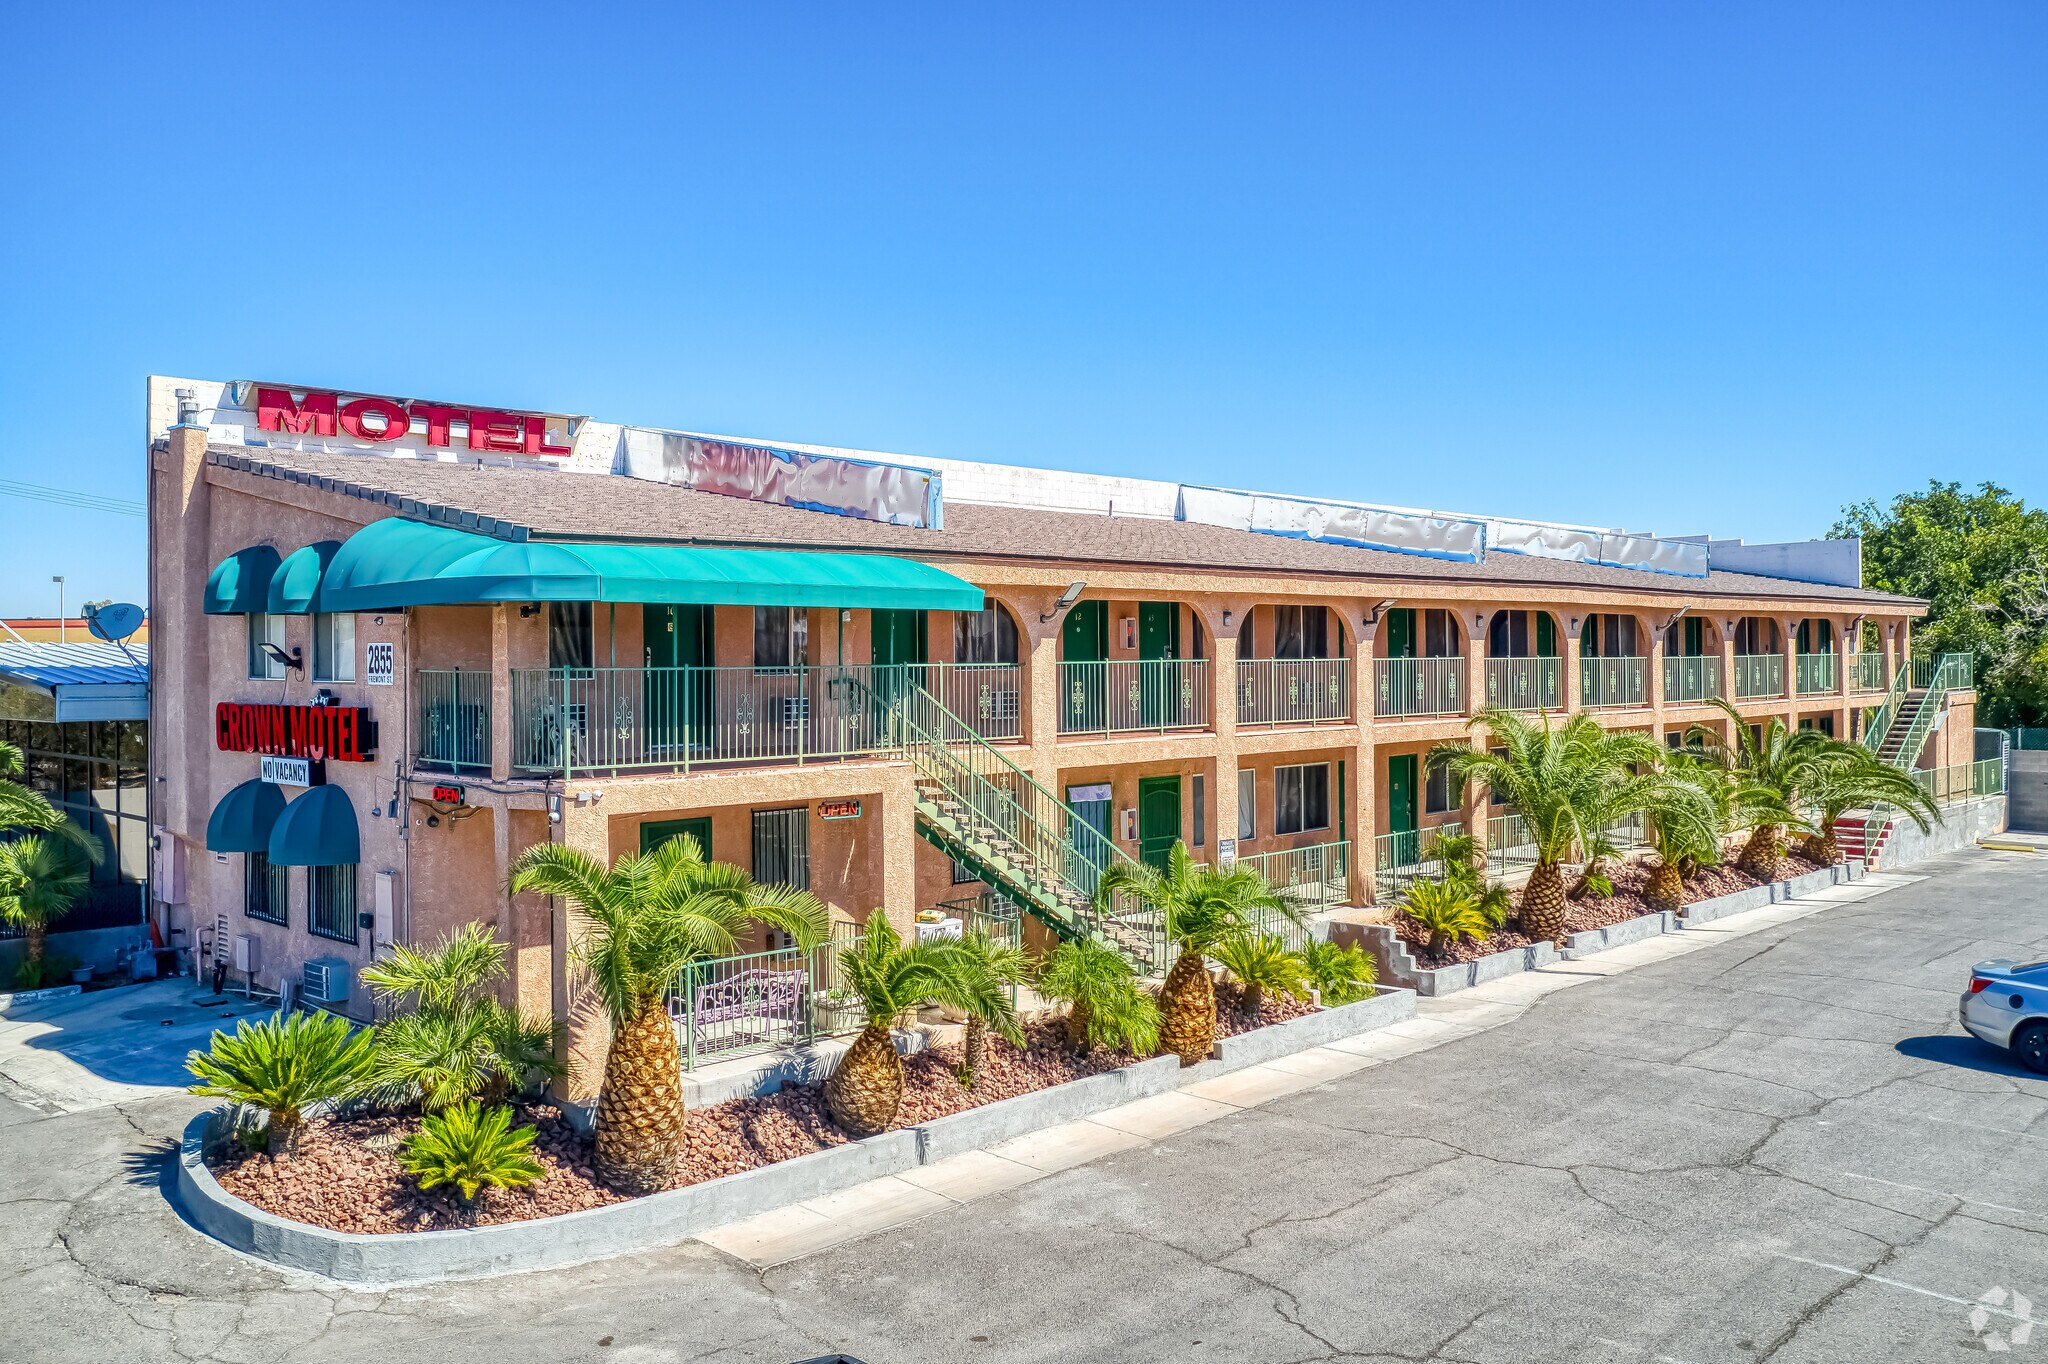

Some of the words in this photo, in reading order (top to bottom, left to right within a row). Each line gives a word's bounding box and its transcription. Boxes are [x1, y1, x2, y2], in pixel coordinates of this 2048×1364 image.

[258, 388, 571, 457] MOTEL
[368, 645, 392, 674] 2855
[368, 675, 386, 683] FREMONT
[216, 702, 286, 756] CROWN
[289, 705, 364, 762] MOTEL
[262, 760, 272, 779] NO
[274, 761, 307, 782] VACANCY
[432, 786, 459, 803] OPEN
[820, 802, 858, 816] OPEN
